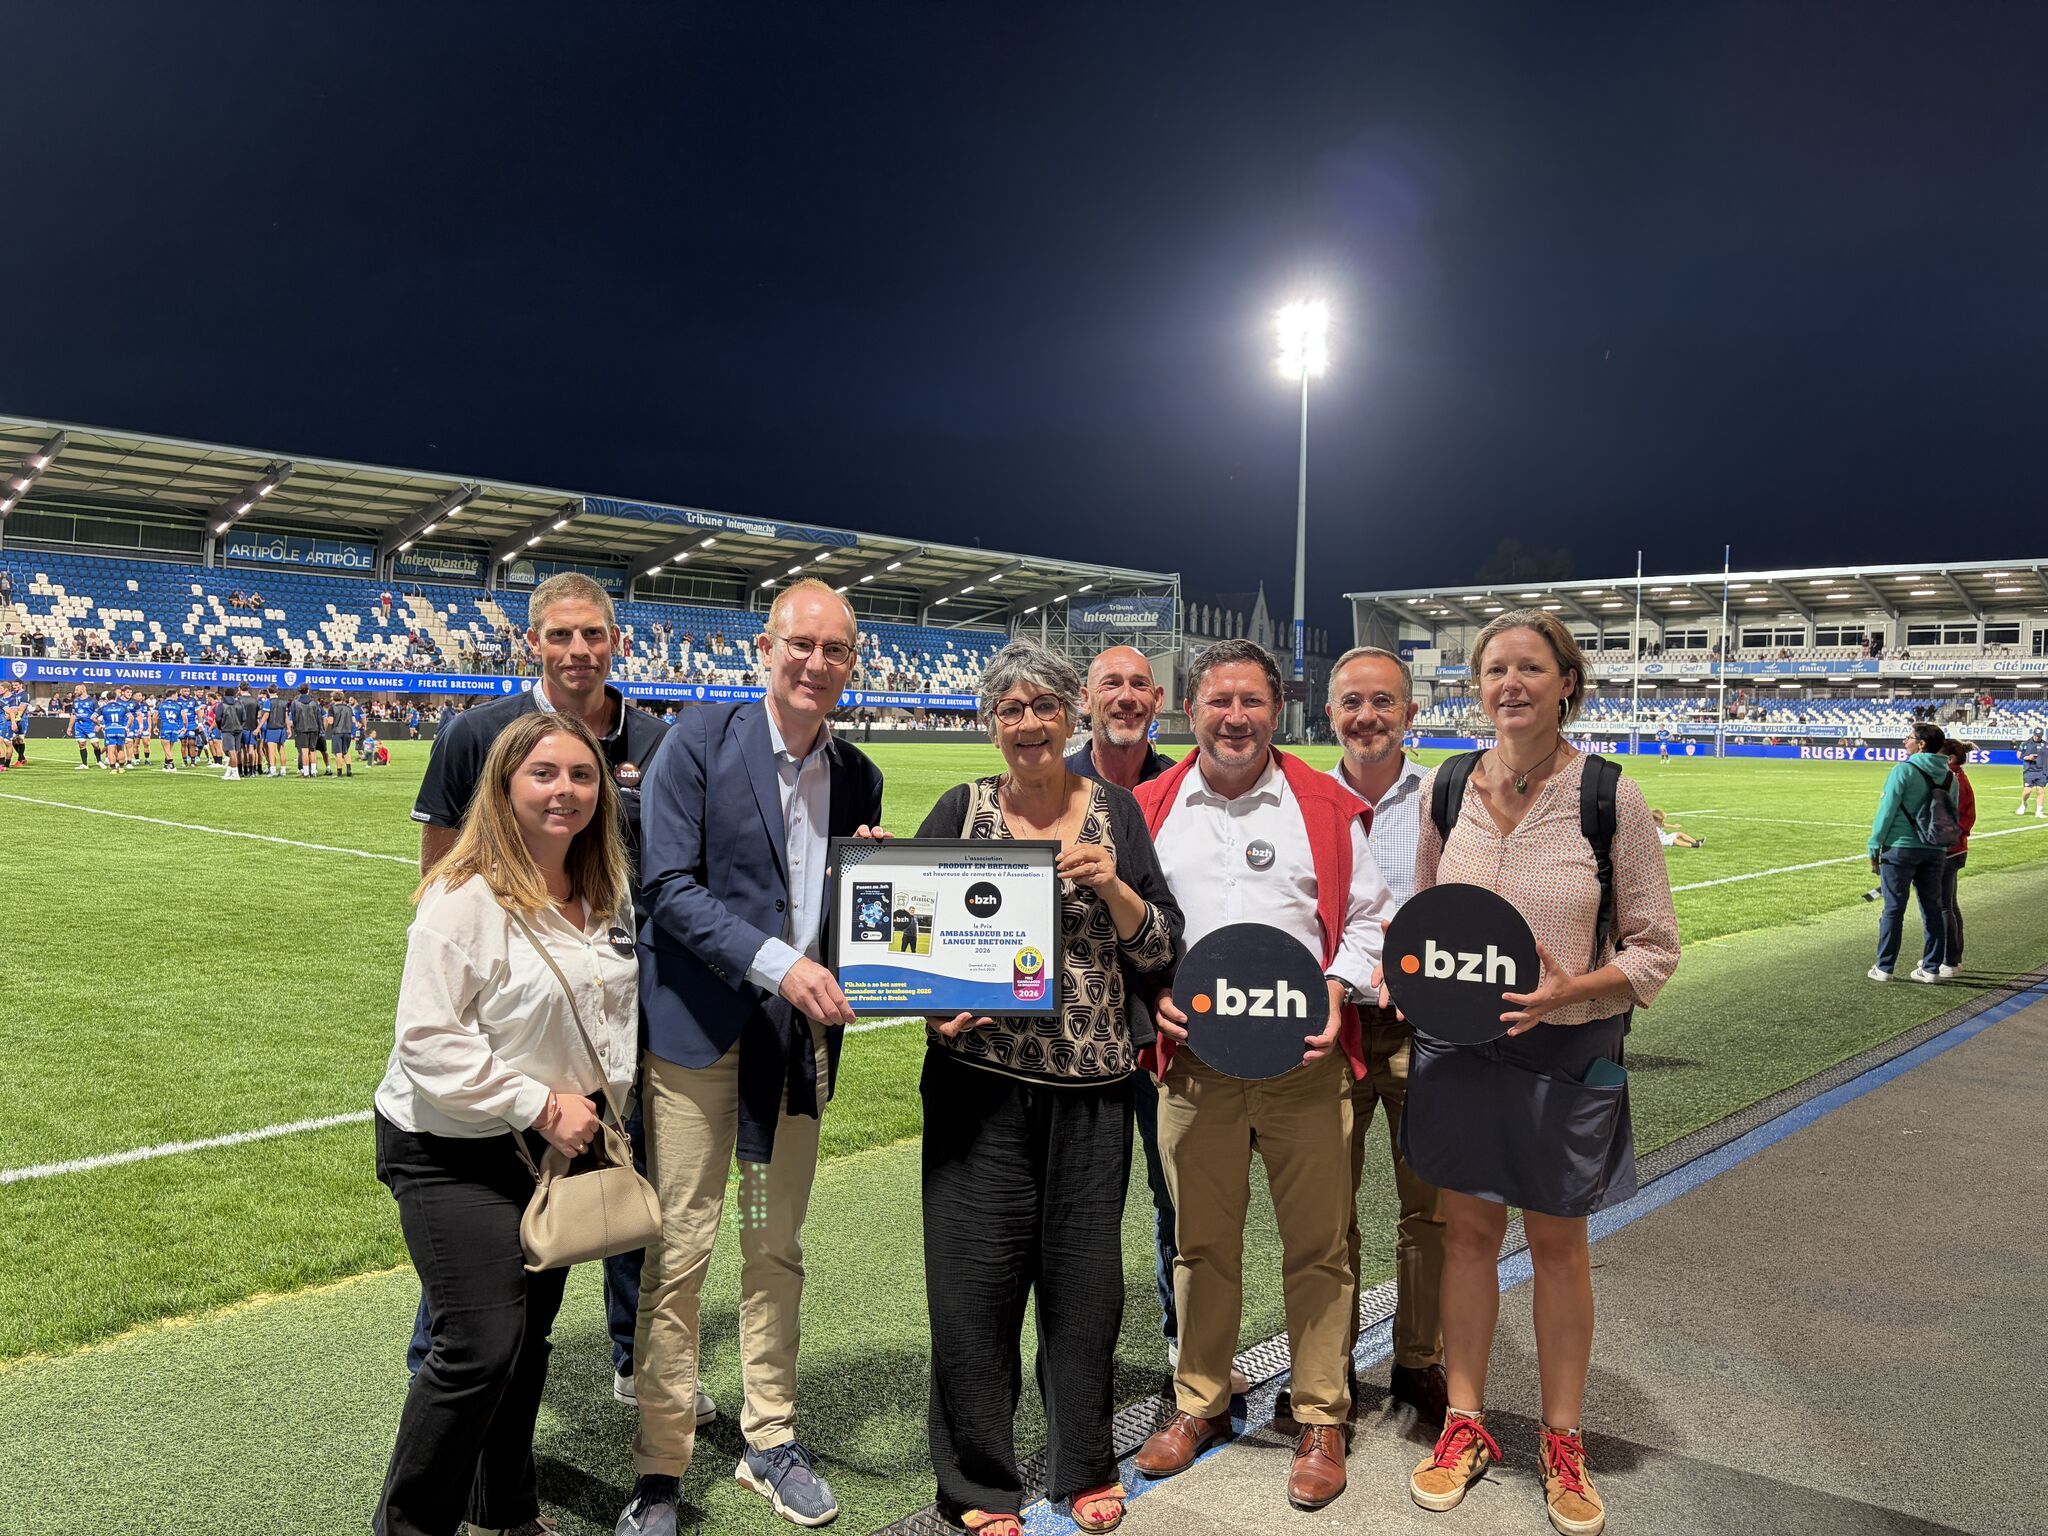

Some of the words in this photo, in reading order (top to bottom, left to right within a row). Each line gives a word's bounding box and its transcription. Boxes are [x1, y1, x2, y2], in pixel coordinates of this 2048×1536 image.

[686, 512, 722, 528] Tribune
[1900, 662, 1924, 671] Cité
[1927, 661, 1971, 671] marine
[1994, 660, 2018, 670] Cité
[38, 666, 78, 676] RUGBY
[82, 666, 112, 677] CLUB
[116, 668, 162, 679] VANNES
[180, 670, 218, 681] FIERTÉ
[222, 672, 278, 683] BRETONNE
[305, 675, 338, 685] RUGBY
[341, 676, 364, 686] CLUB
[367, 678, 404, 687] VANNES
[418, 678, 448, 688] FIERTÉ
[450, 680, 495, 690] BRETONNE
[628, 686, 653, 696] FIERTÉ
[656, 688, 692, 697] BRETONNE
[710, 690, 732, 698] RUGBY
[733, 690, 749, 698] CLUB
[866, 695, 885, 703] RUGBY
[886, 696, 899, 704] CLUB
[900, 696, 922, 704] VANNES
[928, 696, 946, 706] FIERTÉ
[946, 698, 973, 706] BRETONNE
[110, 713, 118, 722] 11
[1959, 727, 2023, 736] CERFRANCE
[1800, 746, 1858, 760] RUGBY
[1864, 748, 1906, 762] CLUB
[1247, 848, 1273, 858] .bzh
[969, 894, 997, 904] .bzh
[1400, 939, 1516, 986] .bzh
[1192, 978, 1307, 1018] .bzh
